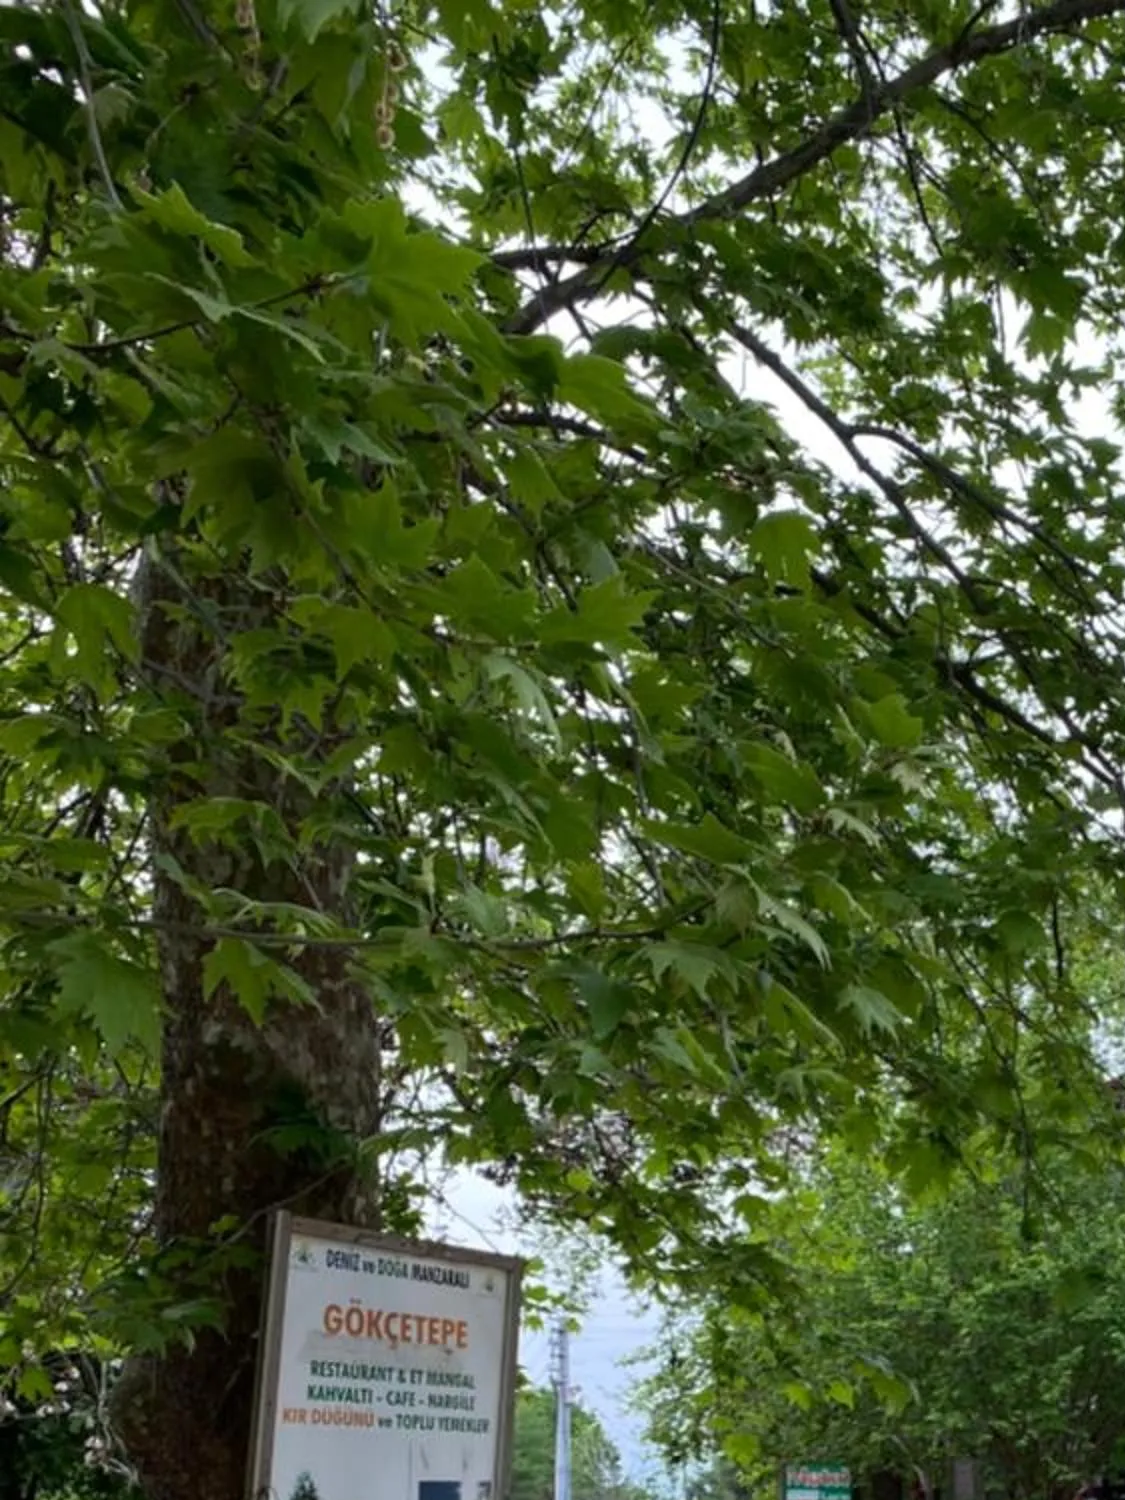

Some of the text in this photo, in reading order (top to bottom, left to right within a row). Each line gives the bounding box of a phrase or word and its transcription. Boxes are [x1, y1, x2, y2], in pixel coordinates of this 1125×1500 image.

[363, 1260, 375, 1274] ve
[324, 1298, 468, 1349] GÖKÇETEPE
[310, 1360, 394, 1381] RESTAURANT
[410, 1368, 423, 1385] ET
[307, 1384, 373, 1404] KAHVALTI
[386, 1390, 415, 1407] CAFE
[283, 1408, 306, 1424] KIR
[378, 1417, 392, 1429] ve
[396, 1413, 434, 1431] TOPLU
